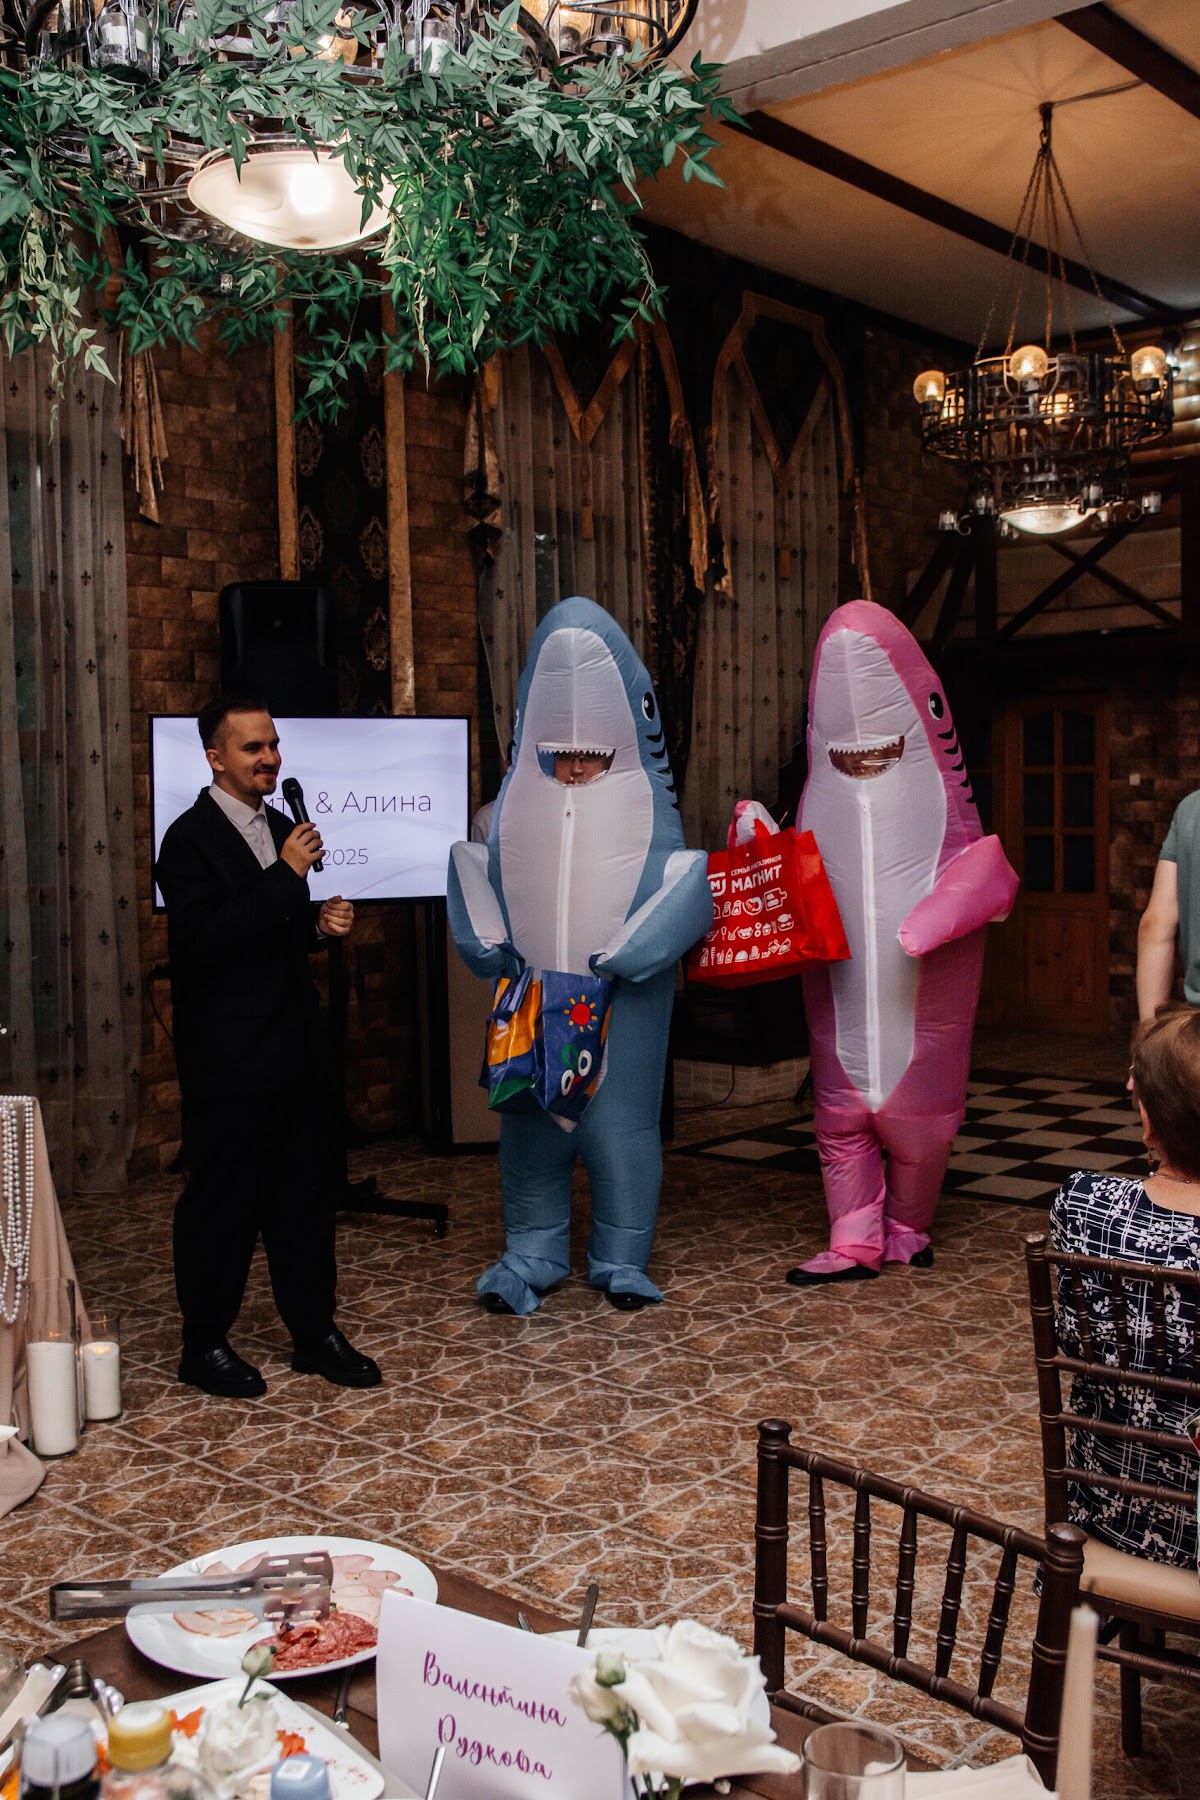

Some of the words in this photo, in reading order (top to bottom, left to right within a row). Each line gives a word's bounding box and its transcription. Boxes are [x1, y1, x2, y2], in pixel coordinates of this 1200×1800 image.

[316, 791, 333, 814] &
[341, 791, 431, 813] Алина
[320, 848, 369, 866] 2025
[731, 864, 782, 893] МАГНИТ
[424, 1650, 567, 1727] Валентина
